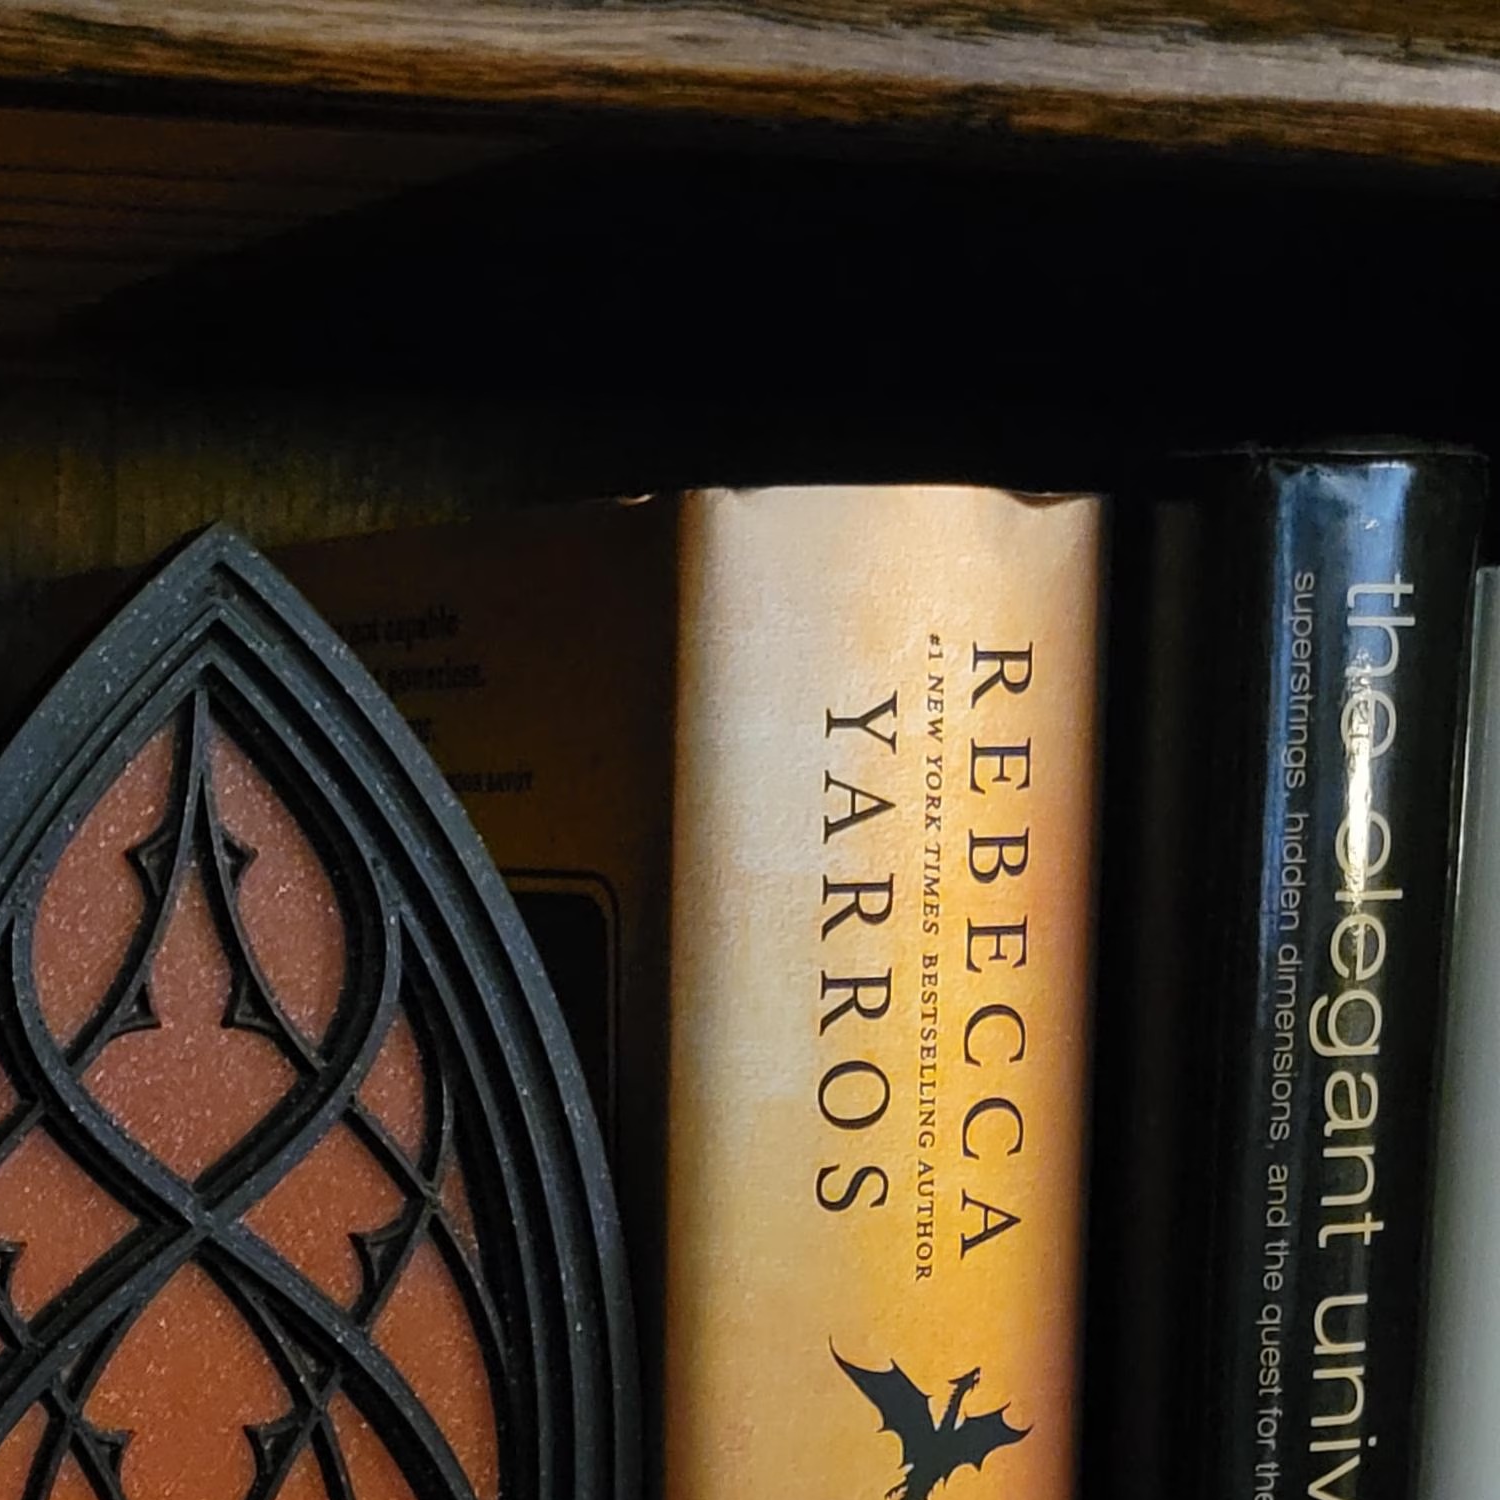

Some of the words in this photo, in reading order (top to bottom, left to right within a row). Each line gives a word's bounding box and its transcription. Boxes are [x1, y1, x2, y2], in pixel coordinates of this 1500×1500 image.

[928, 633, 943, 660] #1
[1281, 571, 1315, 798] superstrings,
[1340, 573, 1416, 761] the
[927, 674, 944, 743] NEW
[925, 755, 943, 832] YORK
[922, 844, 941, 936] TIMES
[1279, 813, 1310, 930] hidden
[815, 691, 899, 1211] YARROS
[959, 641, 1034, 1260] REBECCA
[918, 954, 938, 1148] BESTSELLING
[1265, 943, 1303, 1149] dimensions,
[1308, 811, 1404, 1248] elegant
[915, 1160, 935, 1282] AUTHOR
[1267, 1164, 1292, 1228] and
[1263, 1239, 1290, 1291] the
[1255, 1304, 1283, 1396] quest
[1256, 1406, 1283, 1450] for
